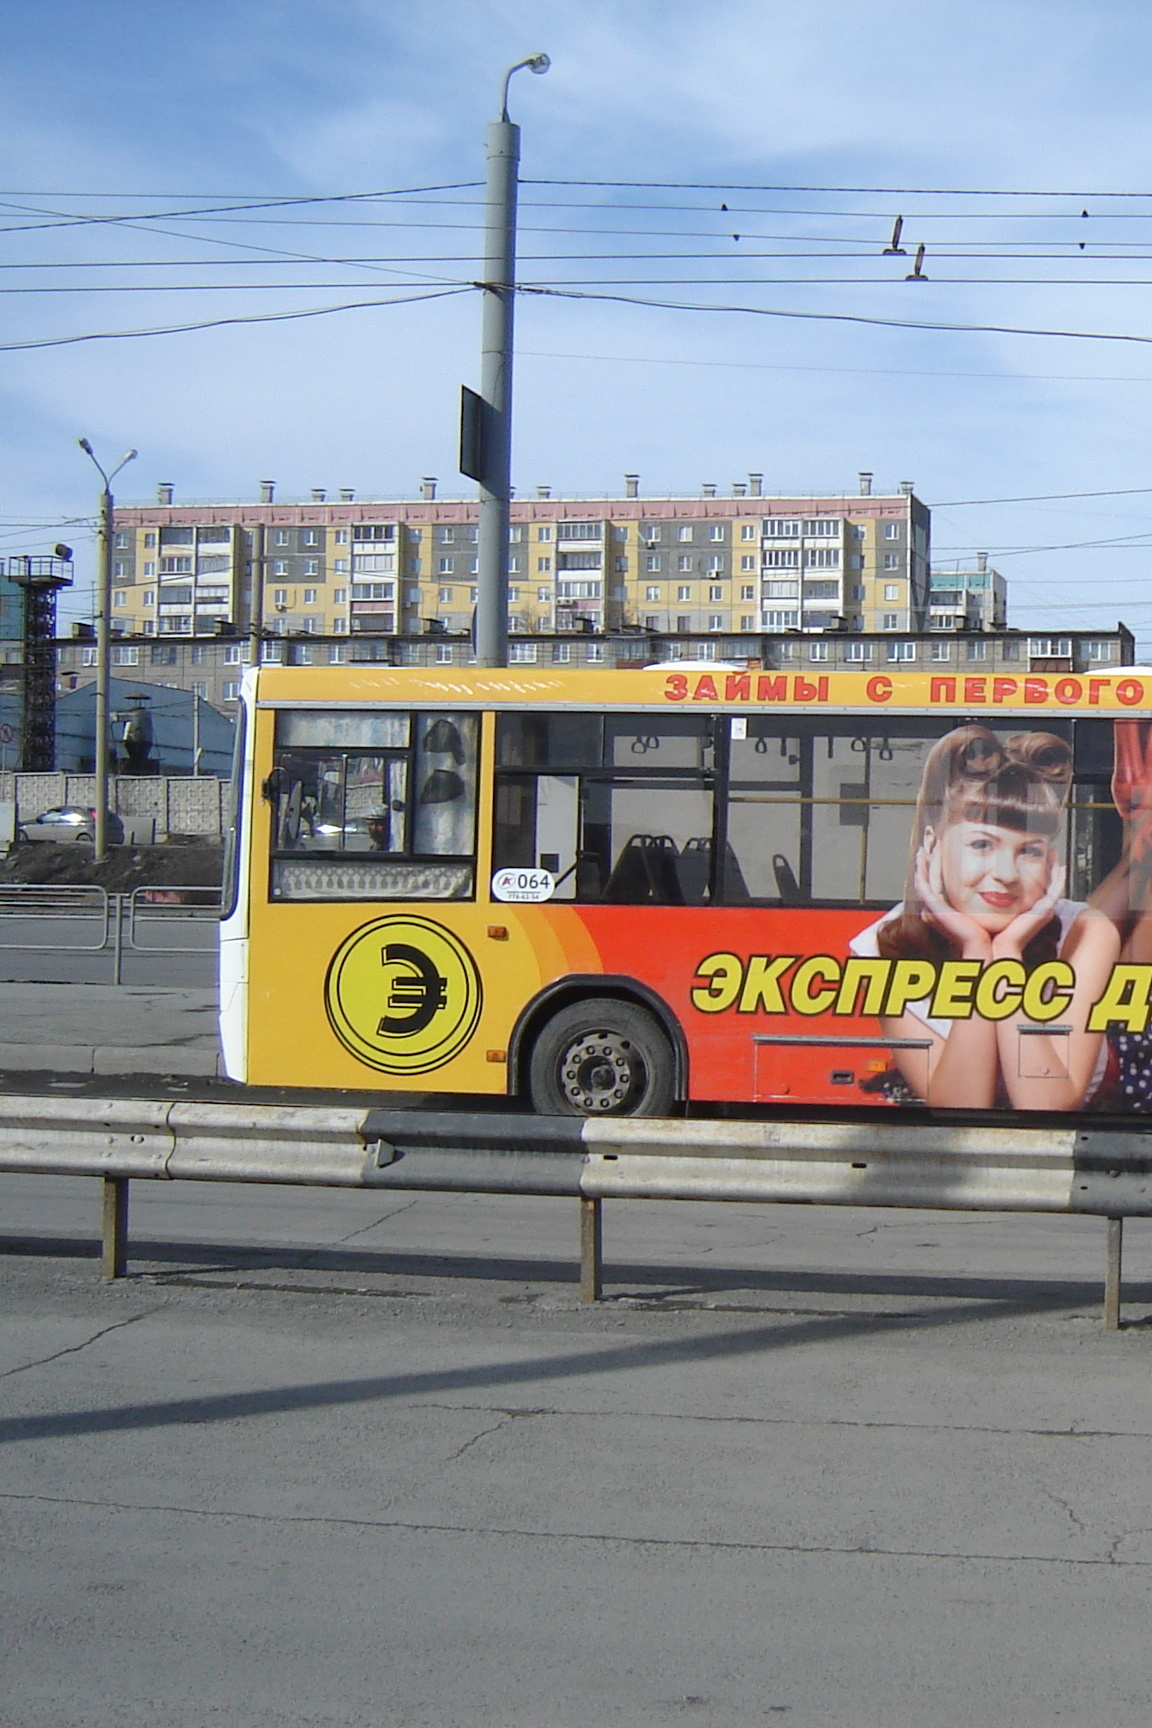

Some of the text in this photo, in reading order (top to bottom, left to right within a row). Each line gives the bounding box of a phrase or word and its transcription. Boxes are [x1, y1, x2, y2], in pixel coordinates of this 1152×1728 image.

[664, 671, 829, 702] ЗАЙМЫ
[866, 676, 893, 702] С
[930, 677, 1145, 706] ПЕРВОГО
[517, 873, 551, 889] 064
[691, 952, 1077, 1021] ЭКСПРЕСС
